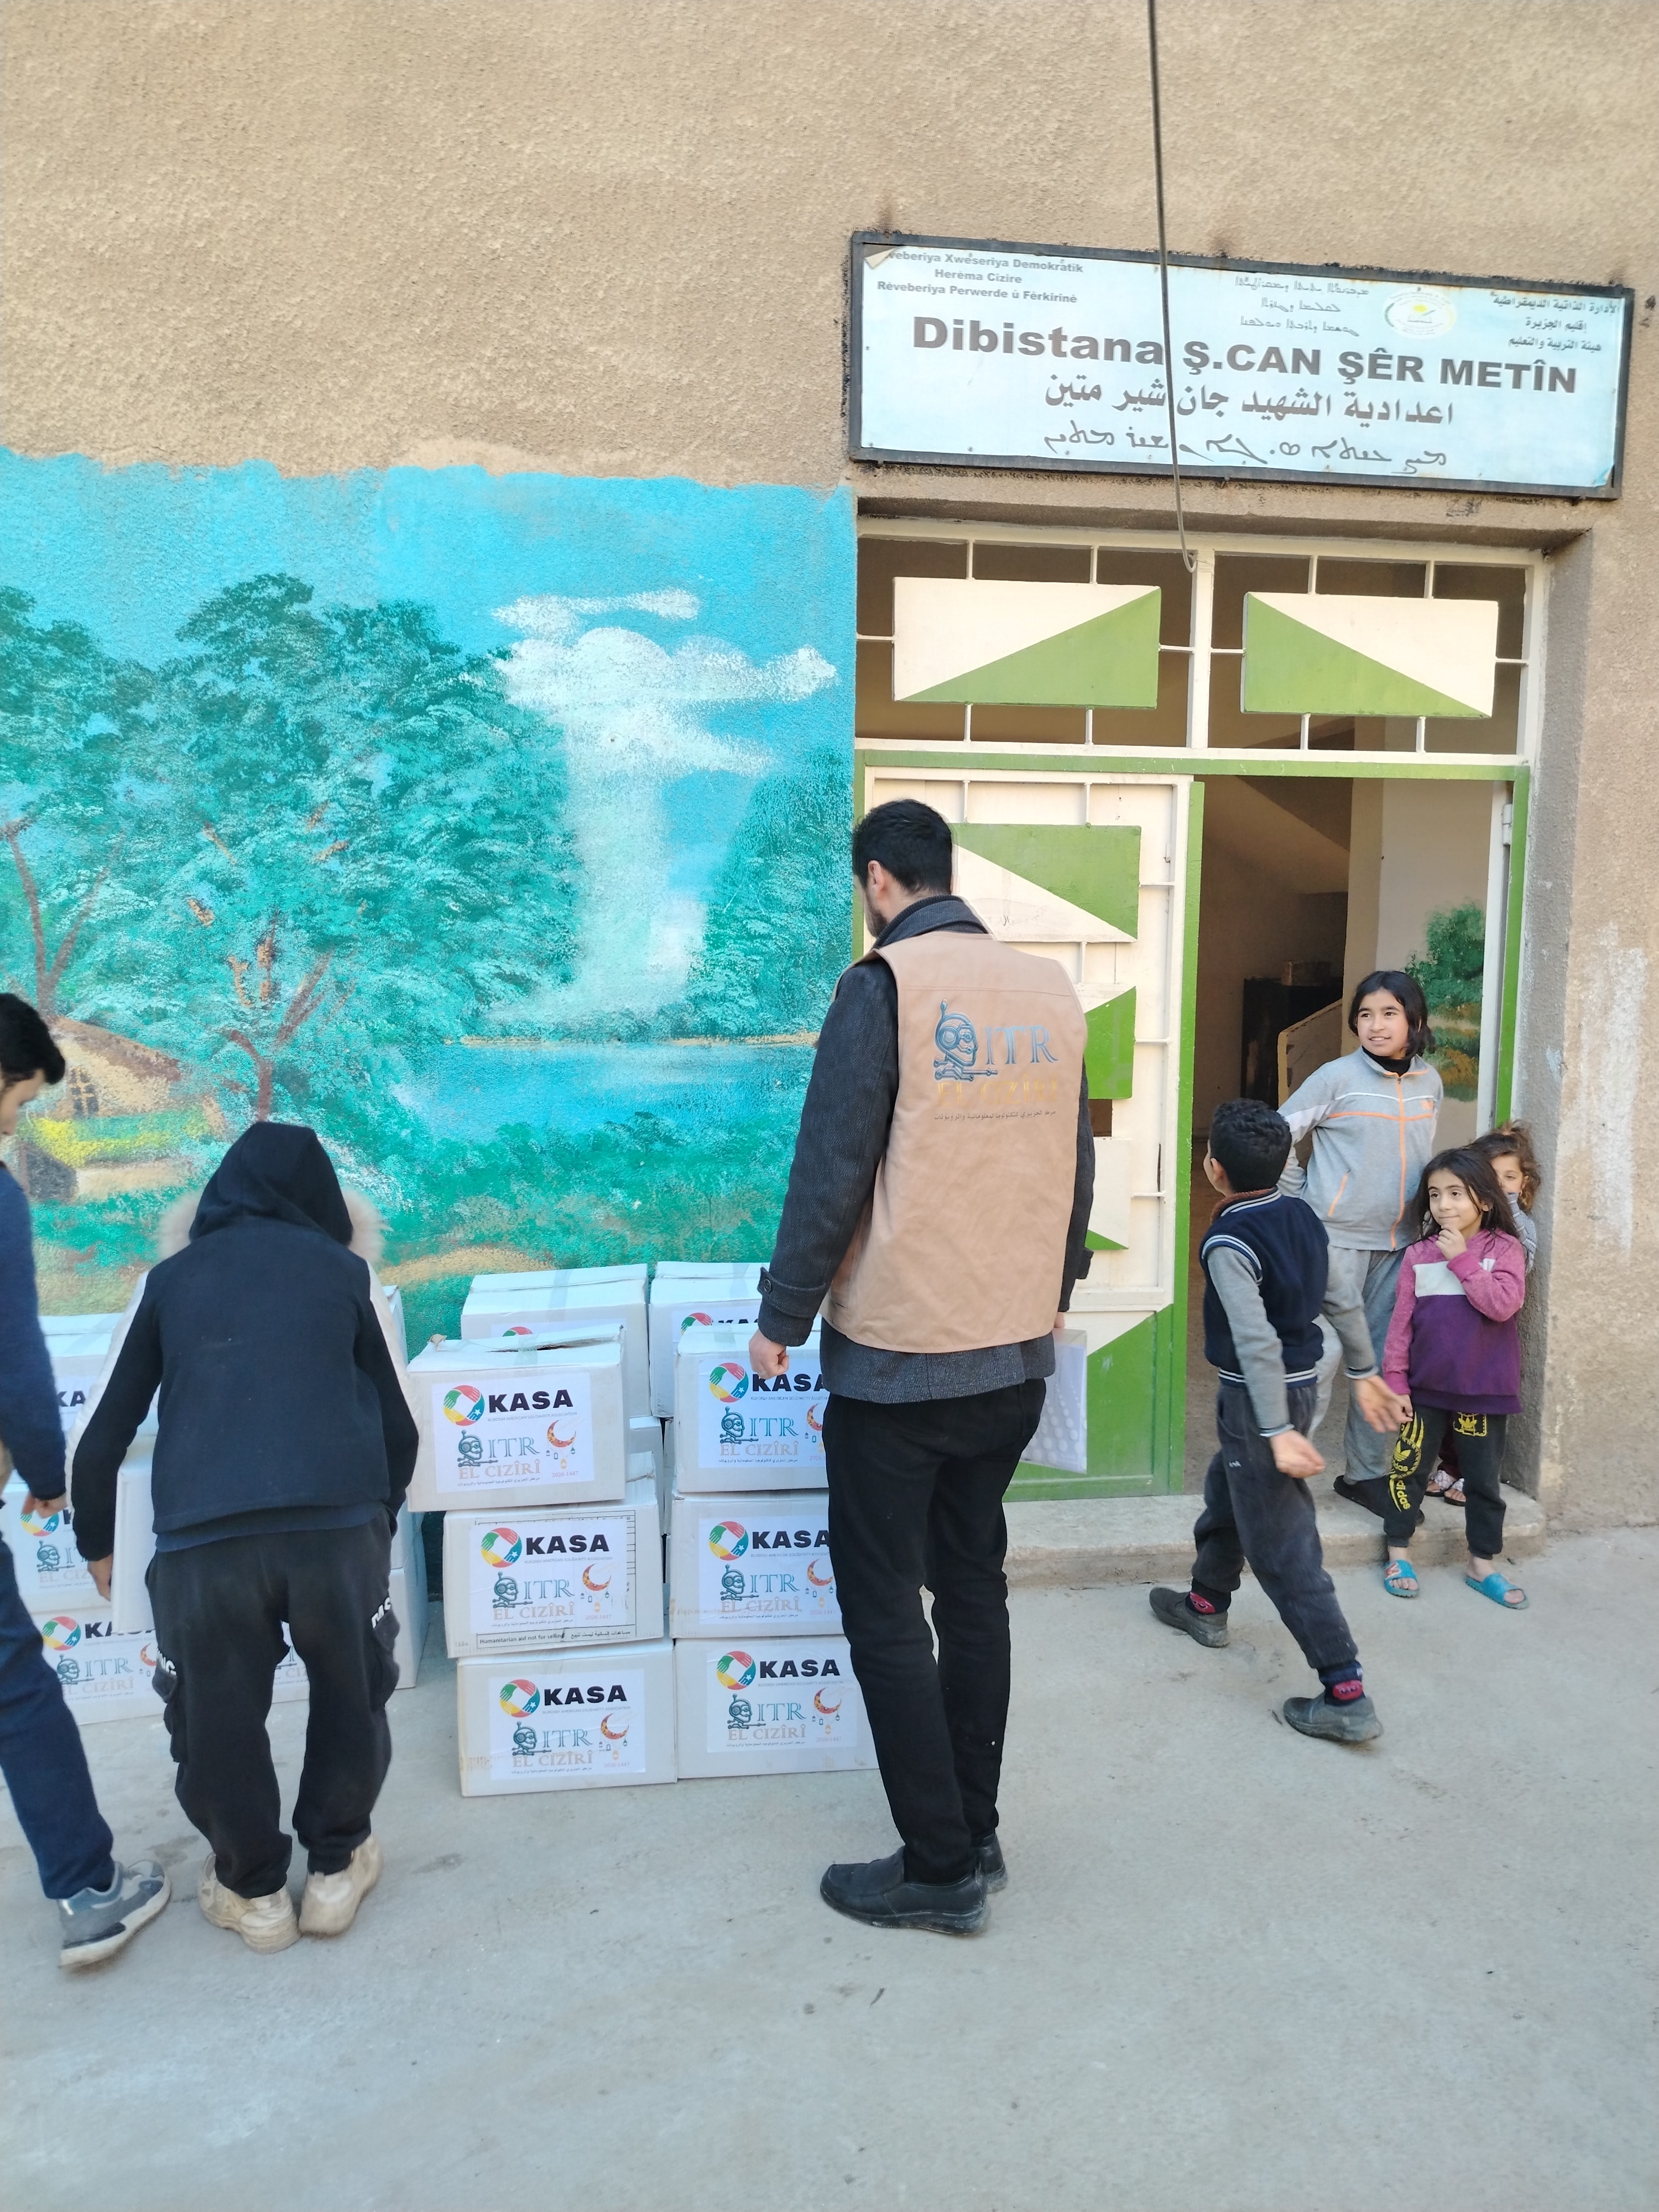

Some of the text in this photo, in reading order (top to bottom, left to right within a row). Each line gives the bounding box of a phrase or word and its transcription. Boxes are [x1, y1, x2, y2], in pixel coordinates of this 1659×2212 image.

[886, 251, 941, 264] veberiya
[950, 285, 1009, 299] Perwerde
[1525, 317, 1562, 330] الجزيرة
[1547, 337, 1578, 351] التربية
[912, 316, 1165, 366] Dibistana
[1337, 347, 1425, 385] ŞÊR
[1439, 358, 1577, 394] METÎN
[1045, 374, 1453, 428] اعدادية الشهيد جان شير متين
[984, 1024, 1058, 1065] ITR
[57, 1390, 86, 1407] KA
[489, 1389, 573, 1413] KASA
[749, 1417, 800, 1437] ITR
[488, 1437, 540, 1459] ITR
[720, 1441, 799, 1456] EL CIZÎRÎ
[459, 1458, 541, 1480] EL CIZÎRÎ
[526, 1535, 610, 1556] KASA
[64, 1569, 91, 1580] CIZ
[750, 1574, 800, 1593] ITR
[524, 1579, 575, 1600] ITR
[493, 1601, 575, 1620] EL CIZÎRÎ
[722, 1600, 740, 1613] EL
[747, 1595, 800, 1612] CIZÎRÎ
[85, 1658, 134, 1678] ITR
[760, 1659, 841, 1678] KASA
[544, 1685, 628, 1706] KASA
[757, 1703, 807, 1722] ITR
[542, 1729, 593, 1748] ITR
[728, 1724, 807, 1740] EL CIZÎRÎ
[513, 1749, 593, 1767] EL CIZÎRÎ
